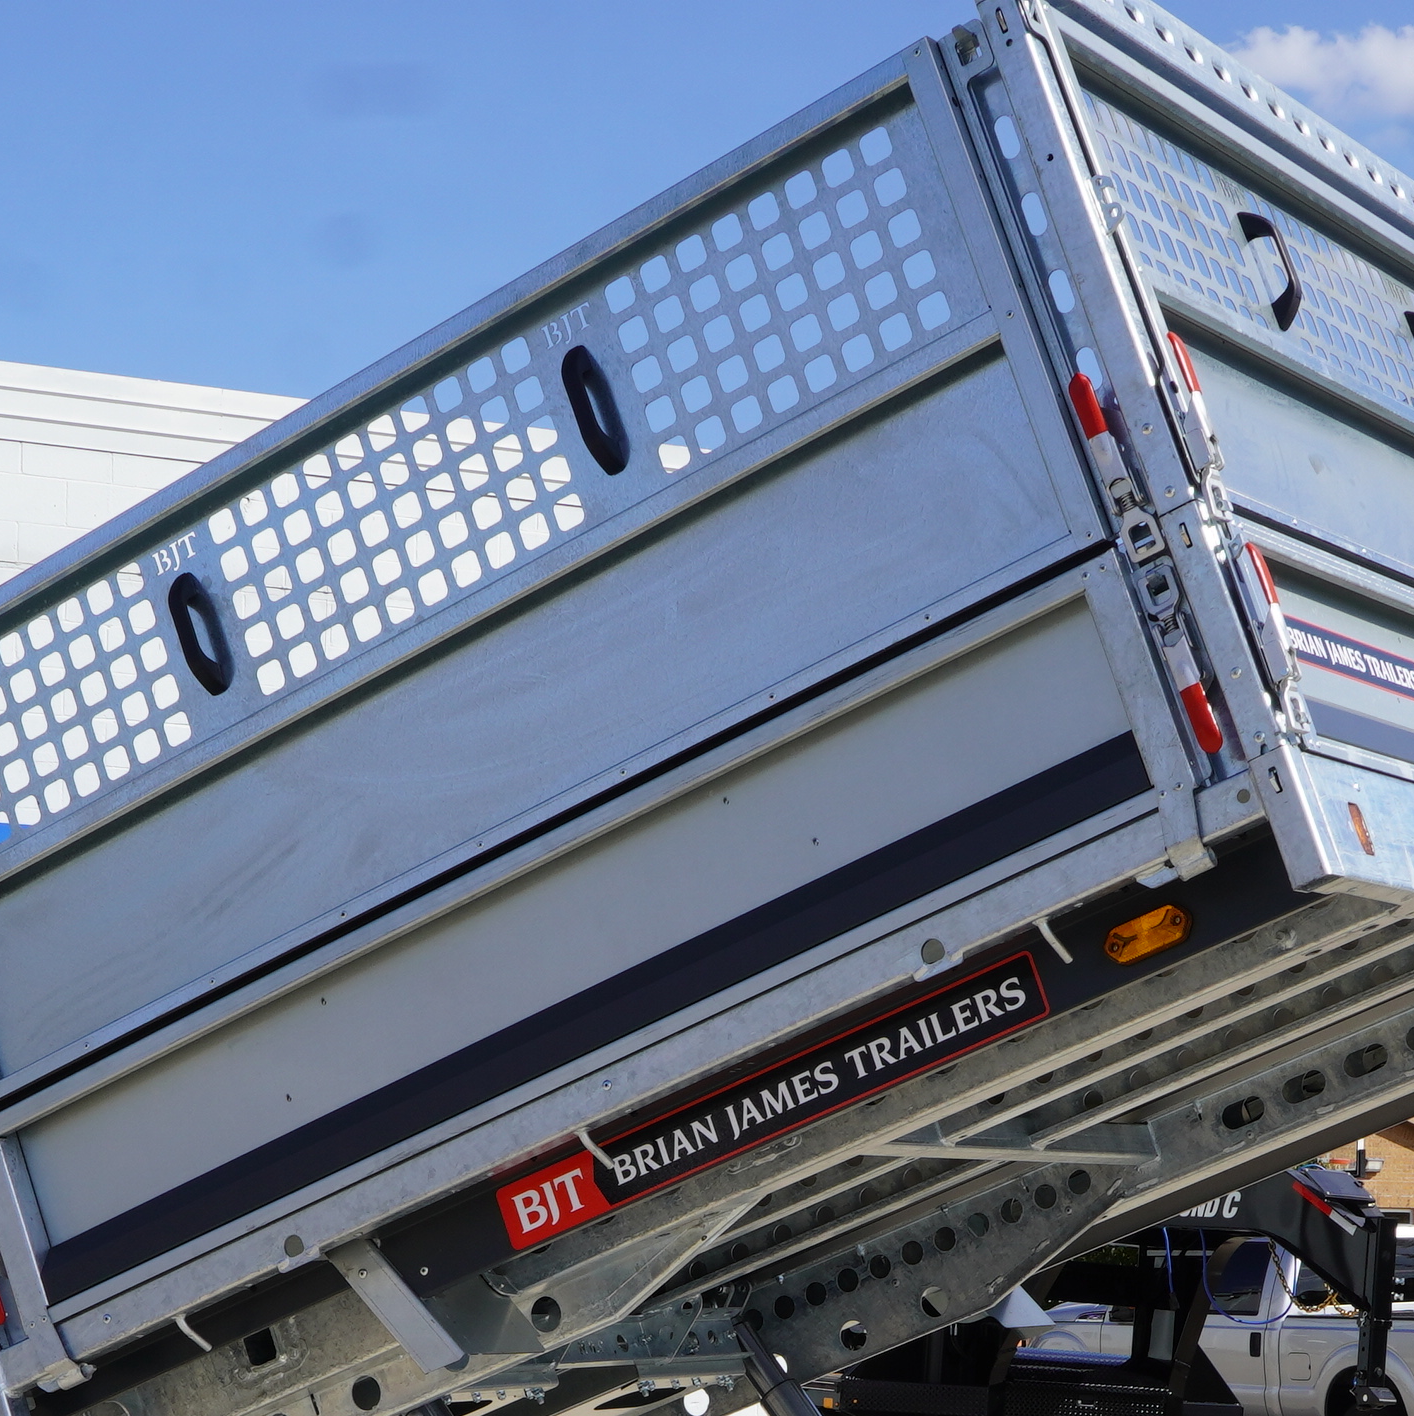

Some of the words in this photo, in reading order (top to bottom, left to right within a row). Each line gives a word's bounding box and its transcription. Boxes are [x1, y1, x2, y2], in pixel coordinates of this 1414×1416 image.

[540, 302, 591, 350] BJT
[152, 531, 198, 576] BJT
[1287, 627, 1328, 659] BRIAN
[1325, 639, 1366, 673] JAMES
[509, 1167, 586, 1236] BJT
[611, 1113, 719, 1188] BRIAN
[724, 1061, 840, 1141] JAMES
[843, 976, 1027, 1080] TRAILERS
